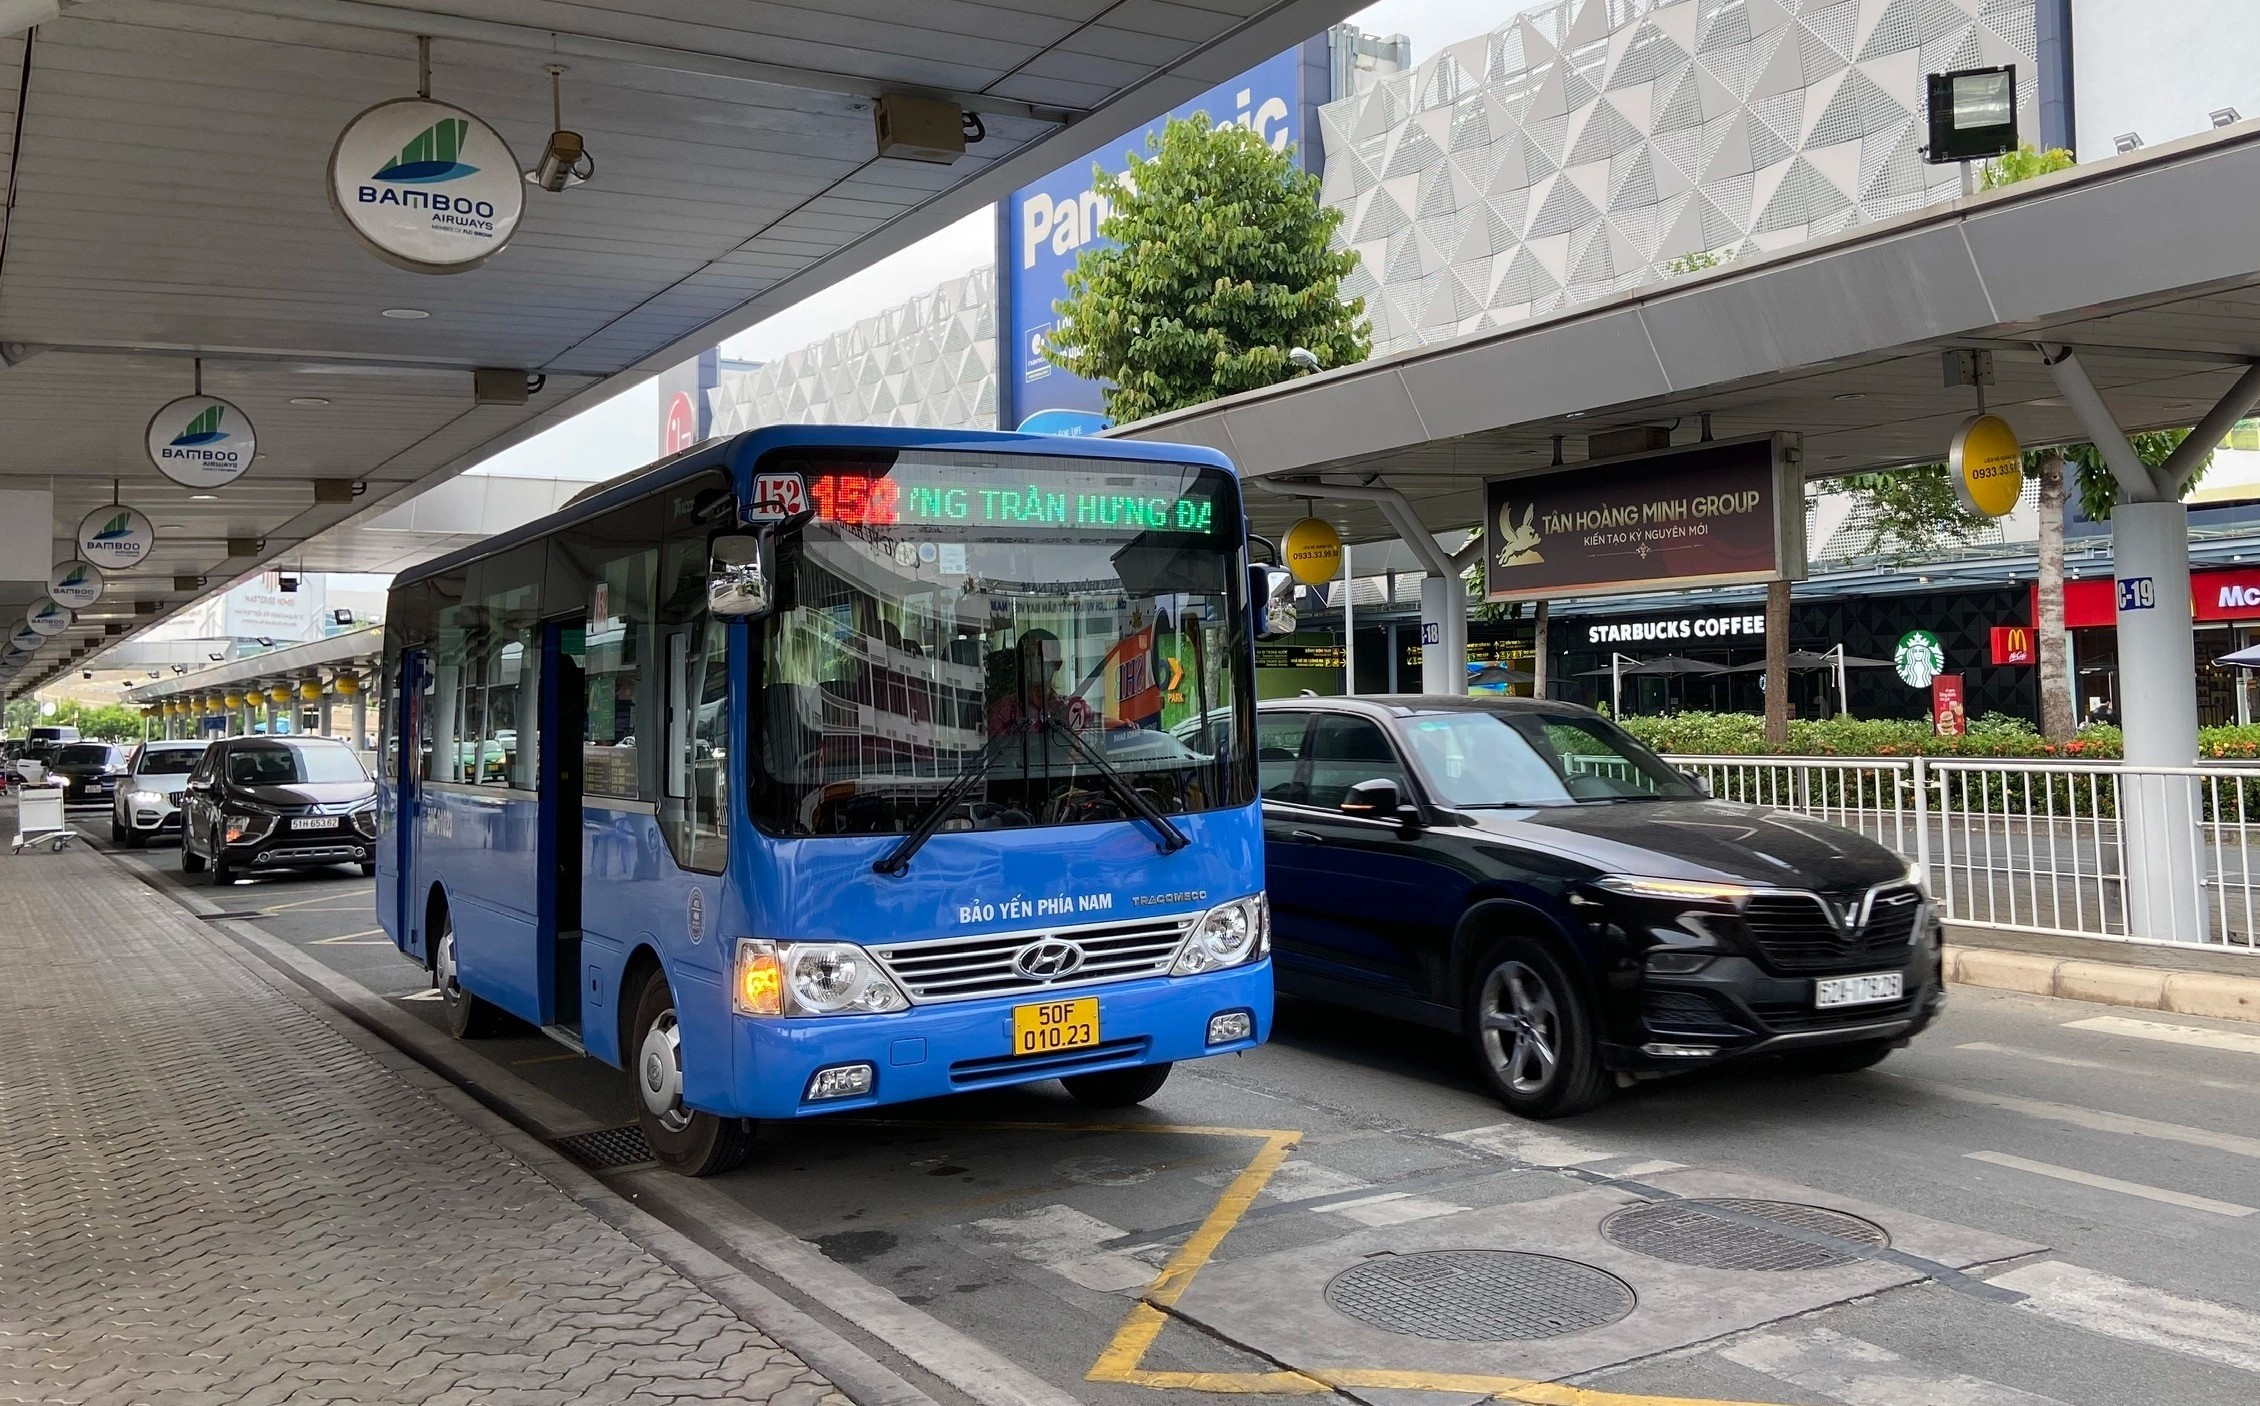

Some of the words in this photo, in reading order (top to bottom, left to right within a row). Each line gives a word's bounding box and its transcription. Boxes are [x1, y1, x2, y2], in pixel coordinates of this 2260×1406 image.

[358, 186, 494, 218] BAMBOO
[432, 213, 493, 230] AIRWAYS
[162, 448, 238, 461] BAMBOO
[758, 479, 801, 514] 152
[811, 475, 900, 525] 152
[1077, 492, 1168, 527] HƯNG
[1541, 509, 1573, 535] TÂN
[1576, 503, 1639, 531] HOÀNG
[1642, 498, 1687, 524] MINH
[1691, 490, 1760, 518] GROUP
[86, 541, 140, 550] BAMBOO
[1584, 531, 1606, 546] KIẾN
[1606, 532, 1627, 546] TẠO
[1645, 524, 1686, 540] NGUYÊN
[1688, 523, 1709, 536] MỚI
[1588, 619, 1691, 643] STARBUCKS
[1693, 614, 1765, 638] COFFEE
[1167, 693, 1184, 703] PARK
[960, 898, 995, 924] BẢO
[1000, 893, 1033, 919] YẾN
[1038, 893, 1074, 916] PHÍA
[1079, 893, 1112, 911] NAM
[1132, 890, 1207, 906] TRACOMECO
[1039, 1003, 1075, 1026] 50F
[1024, 1023, 1090, 1051] 010.23
